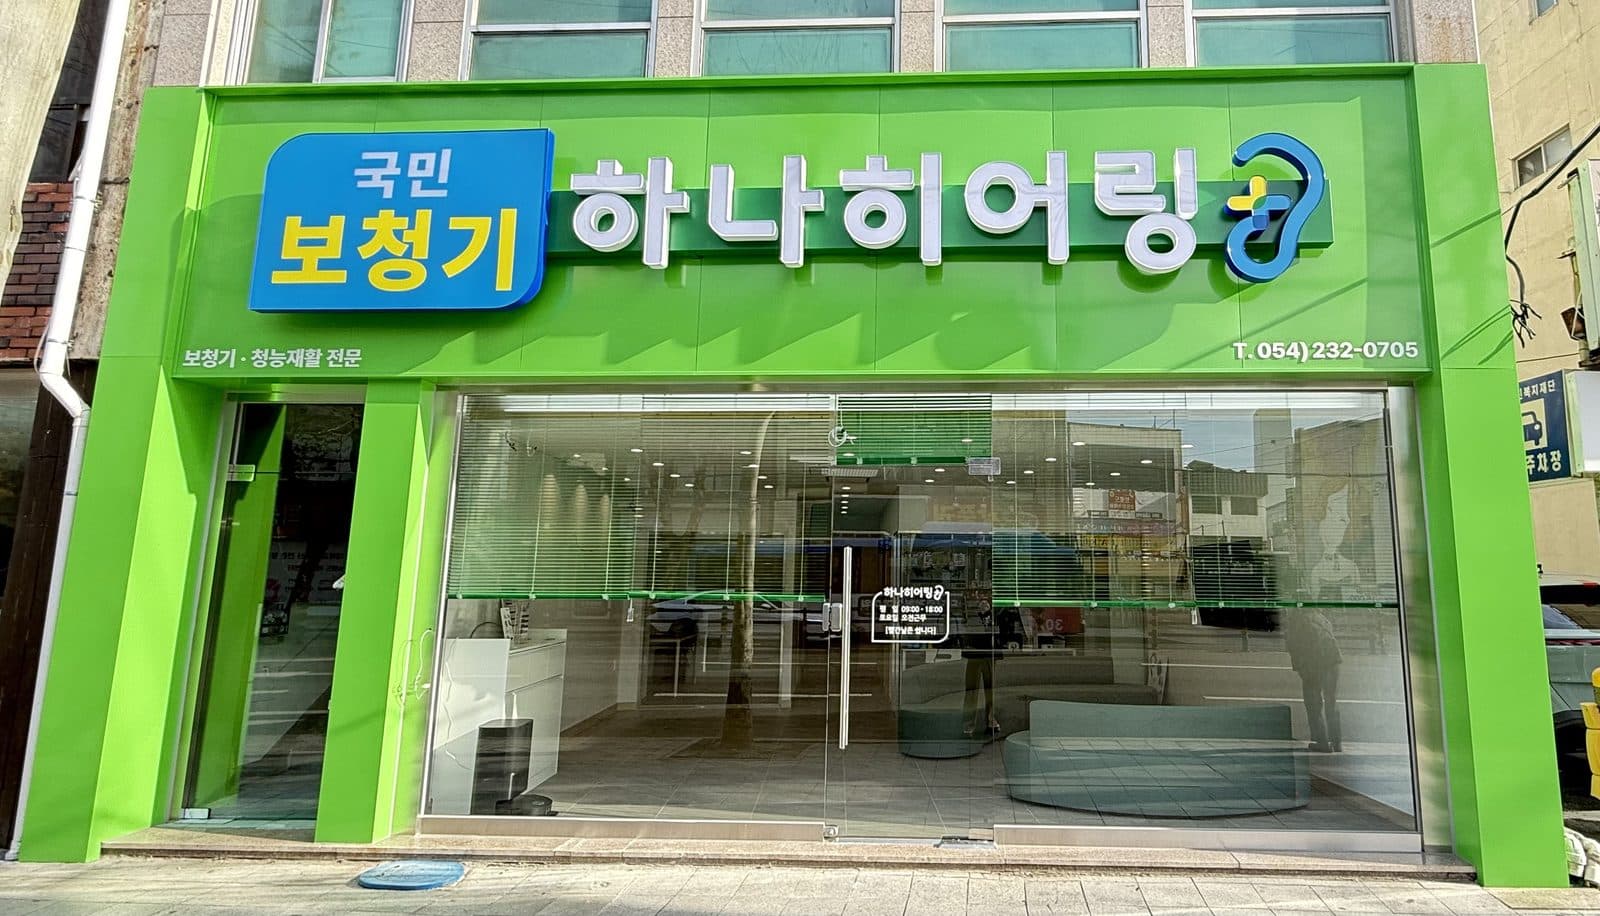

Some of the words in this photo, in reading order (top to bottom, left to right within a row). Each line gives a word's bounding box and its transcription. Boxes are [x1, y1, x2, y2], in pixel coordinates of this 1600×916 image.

[354, 148, 452, 199] 국민
[570, 147, 1198, 275] 하나히어링
[270, 208, 519, 292] 보청기
[182, 348, 237, 369] 보청기
[251, 348, 323, 369] 청능재활
[326, 348, 362, 368] 전문
[1233, 342, 1253, 359] T.
[1312, 341, 1419, 359] 232-0705
[1520, 379, 1556, 399] 복지재단
[883, 586, 933, 599] 하나히어링
